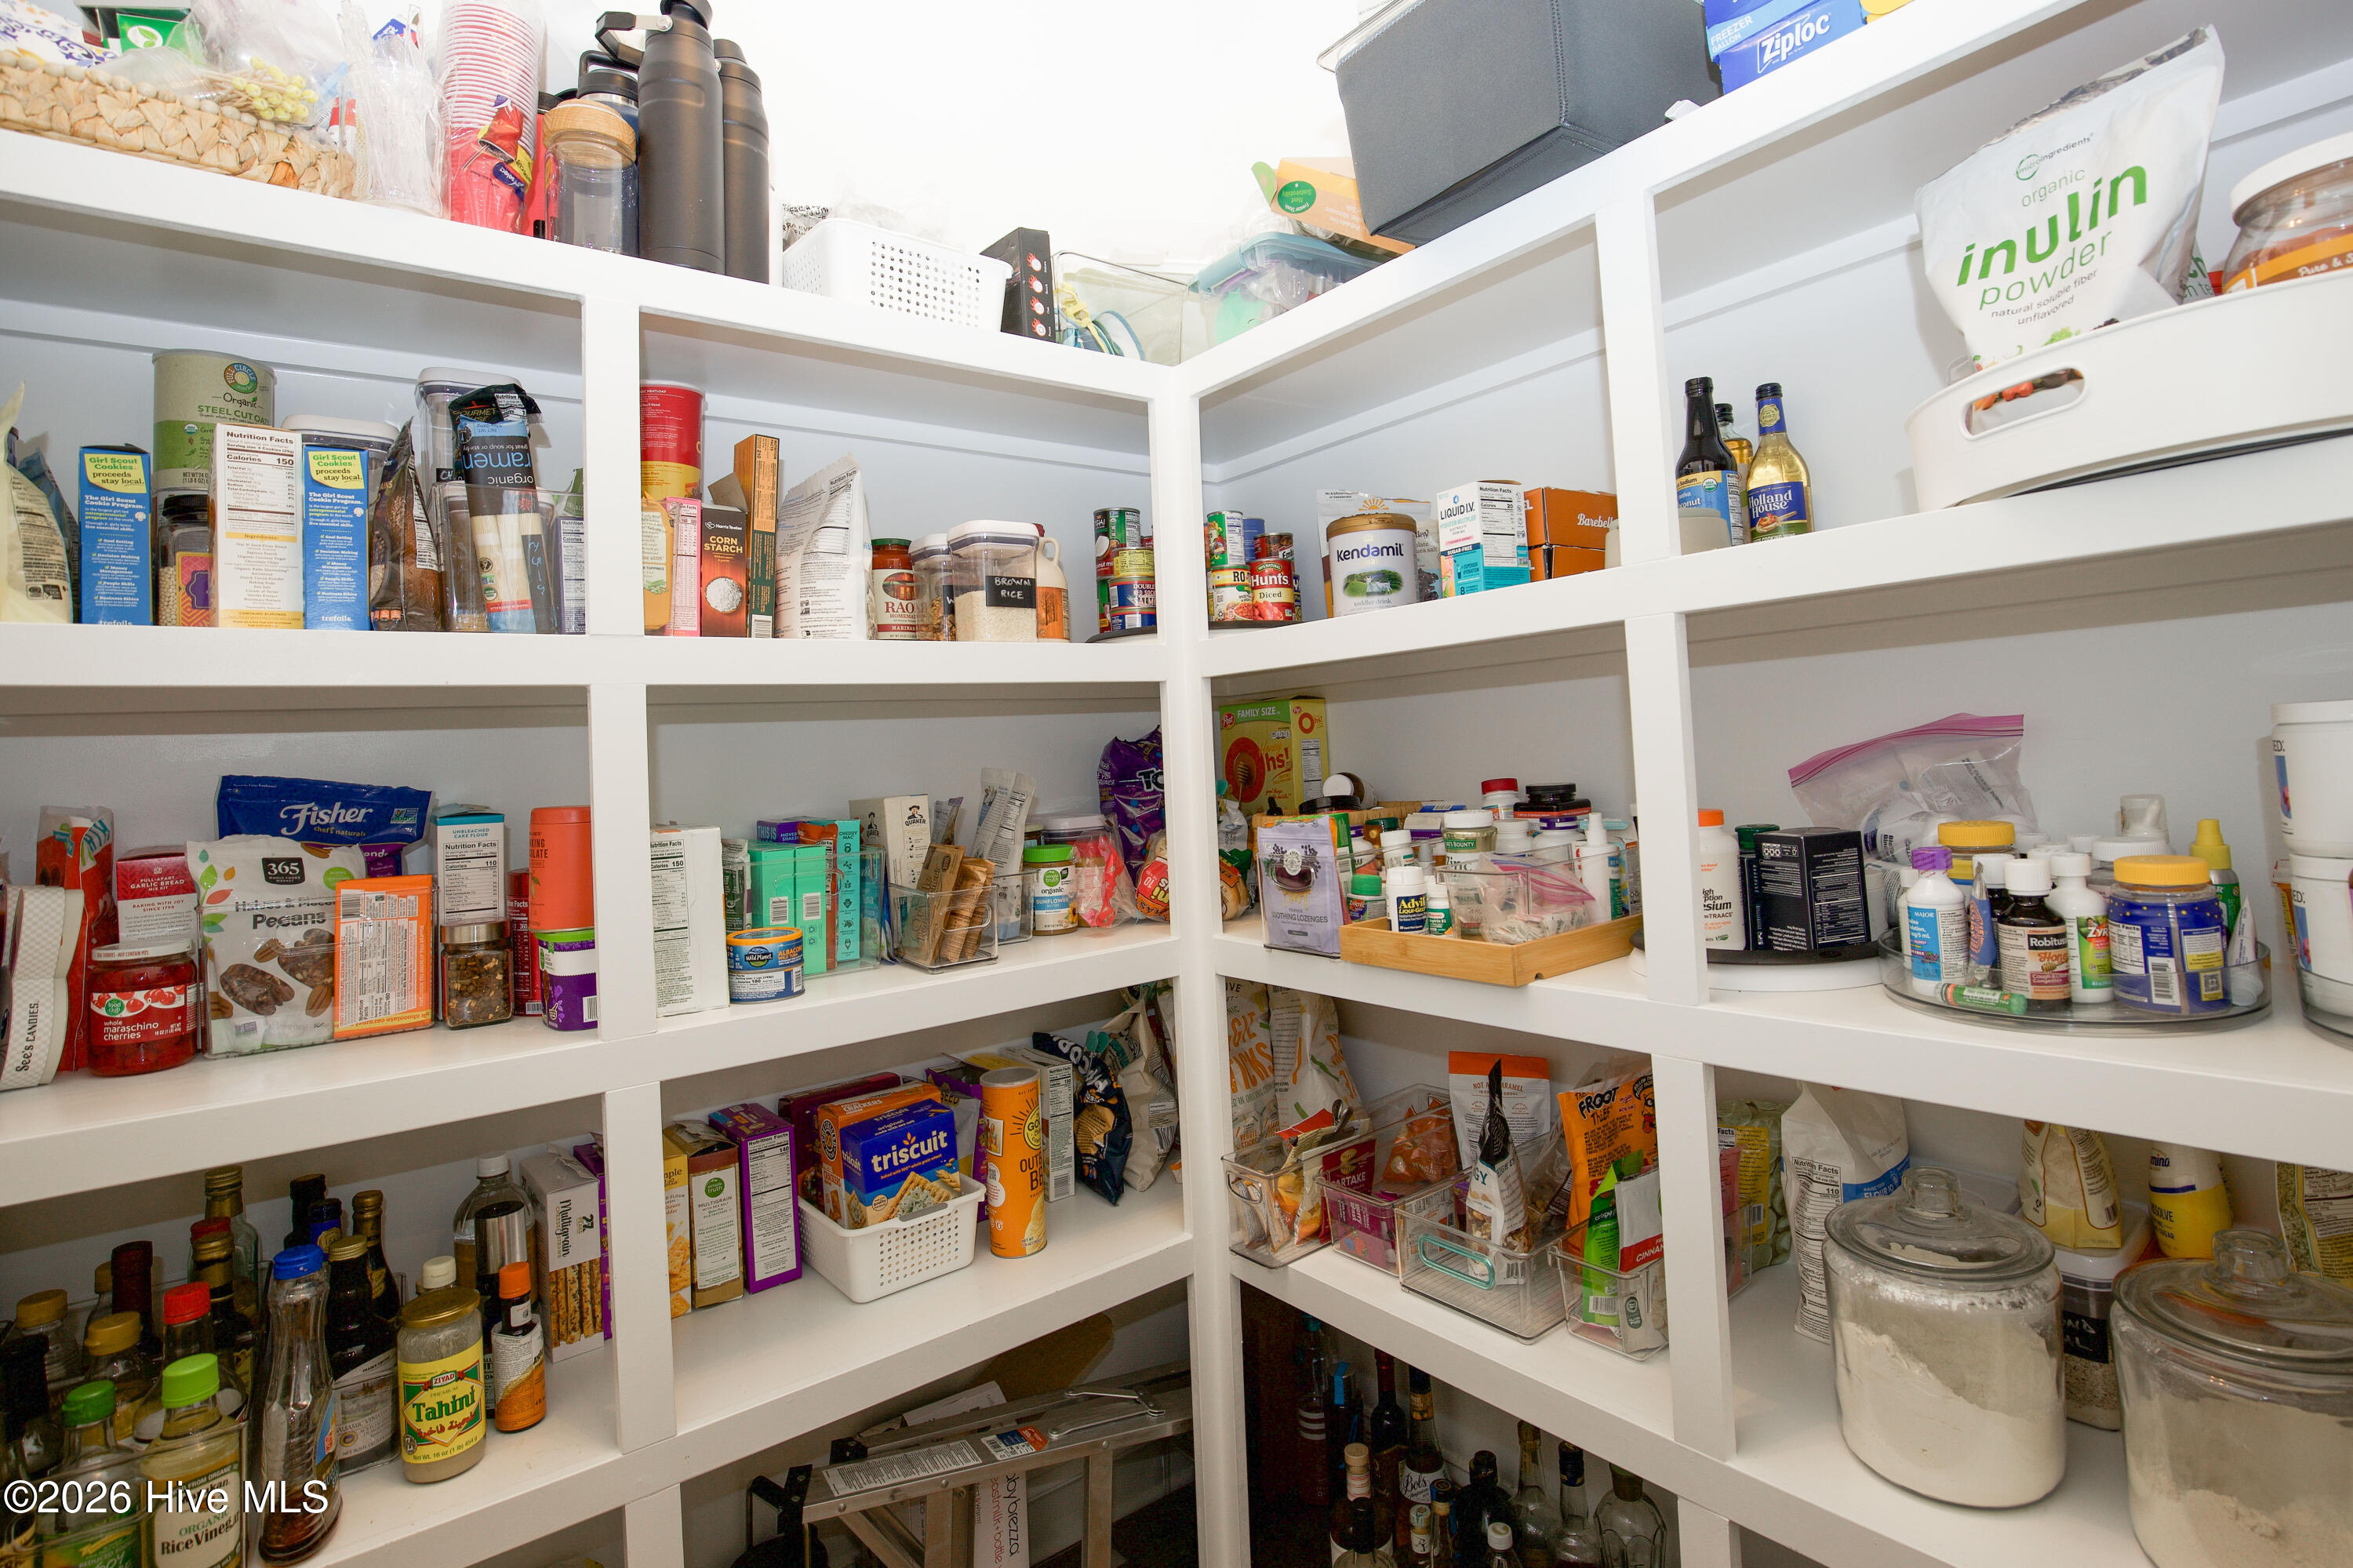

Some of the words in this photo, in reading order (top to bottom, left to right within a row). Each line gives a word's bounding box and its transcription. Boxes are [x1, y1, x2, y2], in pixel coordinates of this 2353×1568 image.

[1711, 15, 1754, 45] FREEZER
[1711, 33, 1741, 53] GALLON
[1761, 14, 1830, 63] Ziploc
[2022, 167, 2086, 208] organic
[1957, 164, 2147, 287] inulin
[1979, 231, 2113, 311] powder
[2297, 260, 2328, 279] Pure
[1991, 301, 2033, 318] natural
[2036, 286, 2071, 309] soluble
[2073, 269, 2098, 289] fiber
[2017, 295, 2075, 326] unflavored
[224, 392, 257, 409] Organic
[198, 404, 231, 417] STEEL
[235, 409, 253, 421] CUT
[227, 431, 267, 441] Nutrition
[463, 452, 532, 469] ramen
[487, 473, 534, 487] organic
[1748, 489, 1793, 508] Holland
[1440, 506, 1465, 520] LIQUID
[1751, 500, 1789, 518] House
[709, 536, 738, 545] CORN
[704, 544, 744, 554] STARCH
[1337, 543, 1403, 562] Kendamil
[1446, 545, 1473, 556] SUGAR-FREE
[995, 577, 1031, 587] BROWN
[1251, 573, 1289, 587] Hunt's
[1001, 590, 1024, 599] RICE
[1237, 708, 1260, 719] FAMILY
[1260, 707, 1277, 716] SIZE
[1223, 715, 1235, 726] Post
[280, 802, 371, 836] Fisher
[904, 818, 926, 827] QUAKER
[336, 828, 366, 837] naturals
[757, 825, 769, 840] THIS
[770, 827, 776, 840] IS
[267, 861, 300, 875] 365
[1041, 886, 1064, 895] organic
[1398, 896, 1427, 910] Advil
[253, 912, 326, 930] Pecans
[104, 1022, 159, 1033] maraschino
[16, 1043, 35, 1072] See's
[26, 1002, 39, 1042] CANDIES
[104, 1031, 142, 1041] cherries
[842, 1099, 883, 1112] CRACKERS
[1578, 1086, 1620, 1119] FROOT
[874, 1108, 911, 1122] triscuit
[878, 1119, 904, 1130] original
[748, 1136, 773, 1145] Nutrition
[774, 1131, 788, 1141] Facts
[871, 1130, 948, 1173] triscuit
[842, 1149, 862, 1172] triscuit
[1497, 1166, 1508, 1177] HIGH
[1818, 1164, 1839, 1175] Facts
[707, 1184, 723, 1194] truth
[698, 1195, 733, 1208] MULTIGRAIN
[1595, 1211, 1613, 1221] crispy
[559, 1199, 572, 1258] Multigrain
[433, 1373, 456, 1385] ZIYAD
[430, 1385, 459, 1399] PREMIUM
[412, 1384, 477, 1424] Tahini
[1404, 1472, 1427, 1493] Bols
[161, 1541, 194, 1555] Rice
